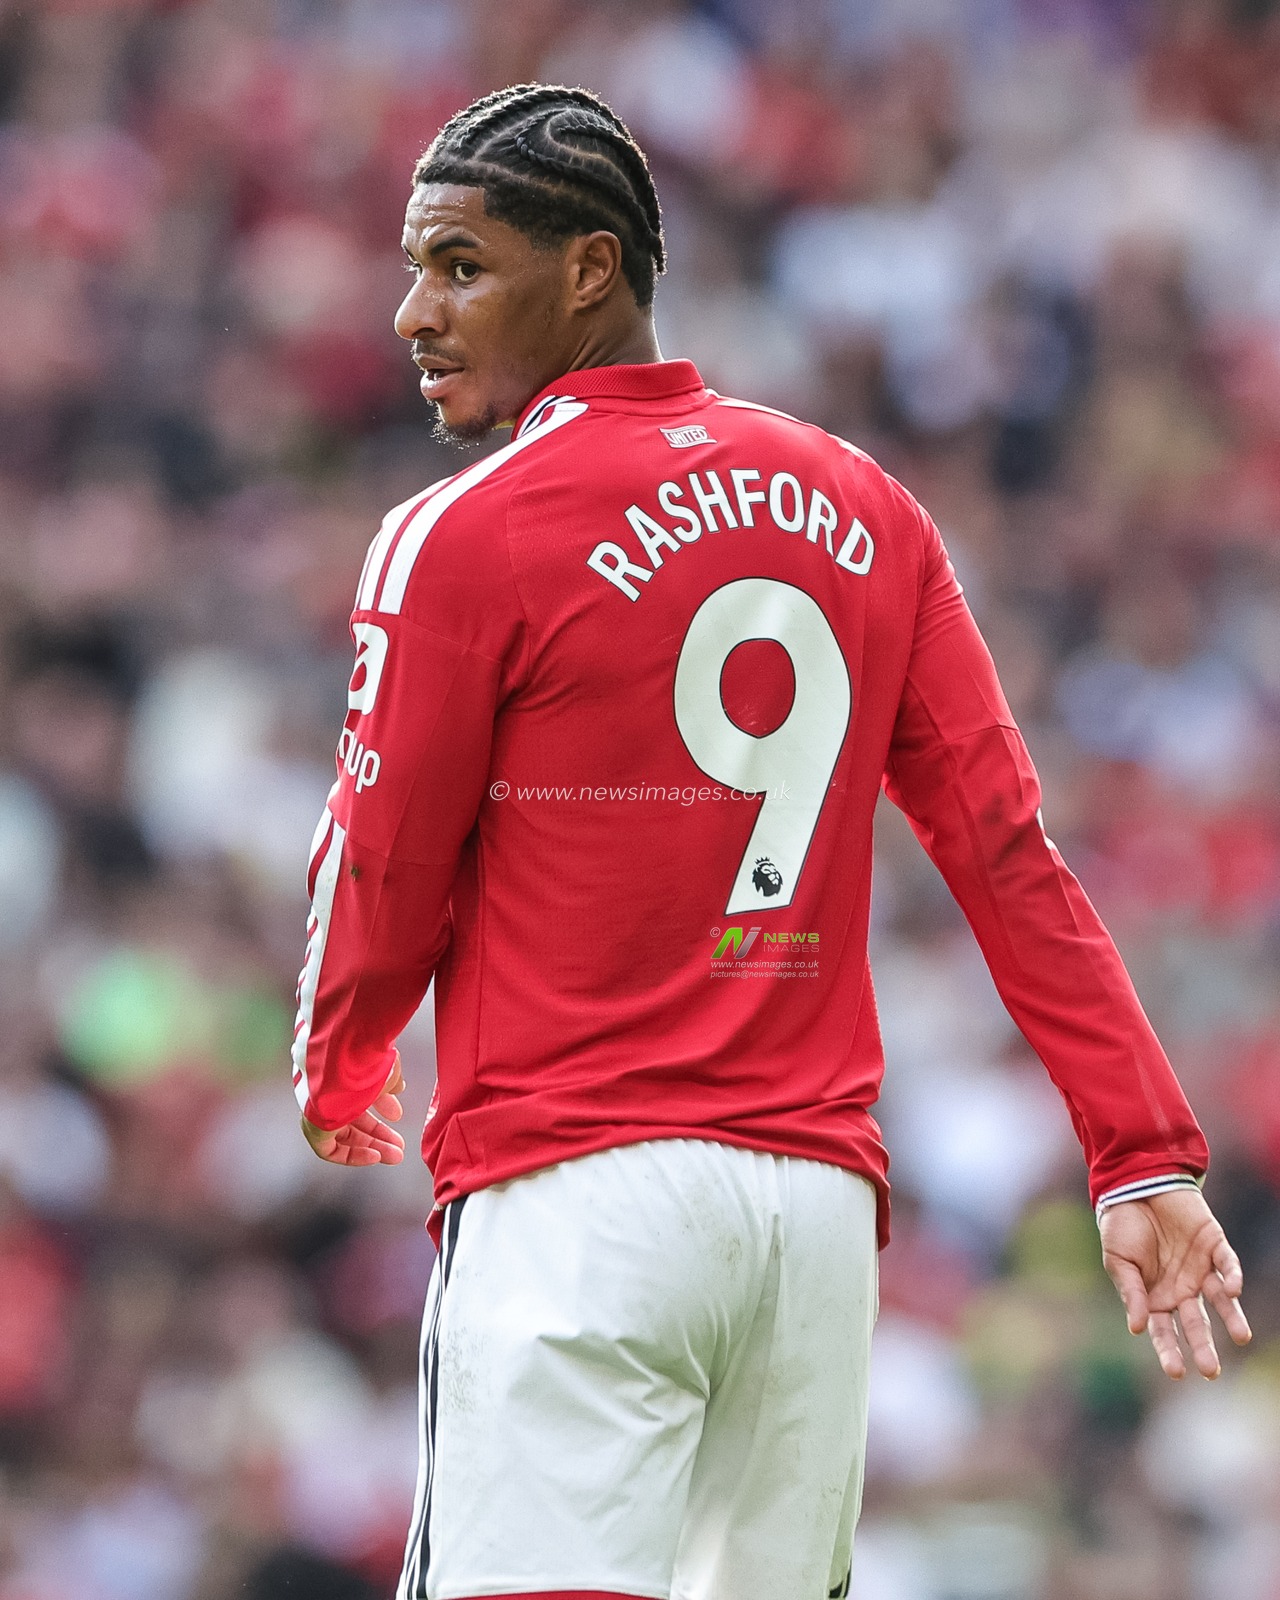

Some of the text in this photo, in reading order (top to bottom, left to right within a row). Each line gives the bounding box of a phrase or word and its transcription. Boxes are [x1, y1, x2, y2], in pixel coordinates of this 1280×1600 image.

[664, 429, 708, 445] UNITED
[586, 468, 875, 603] RASHFORD
[673, 577, 852, 917] 9
